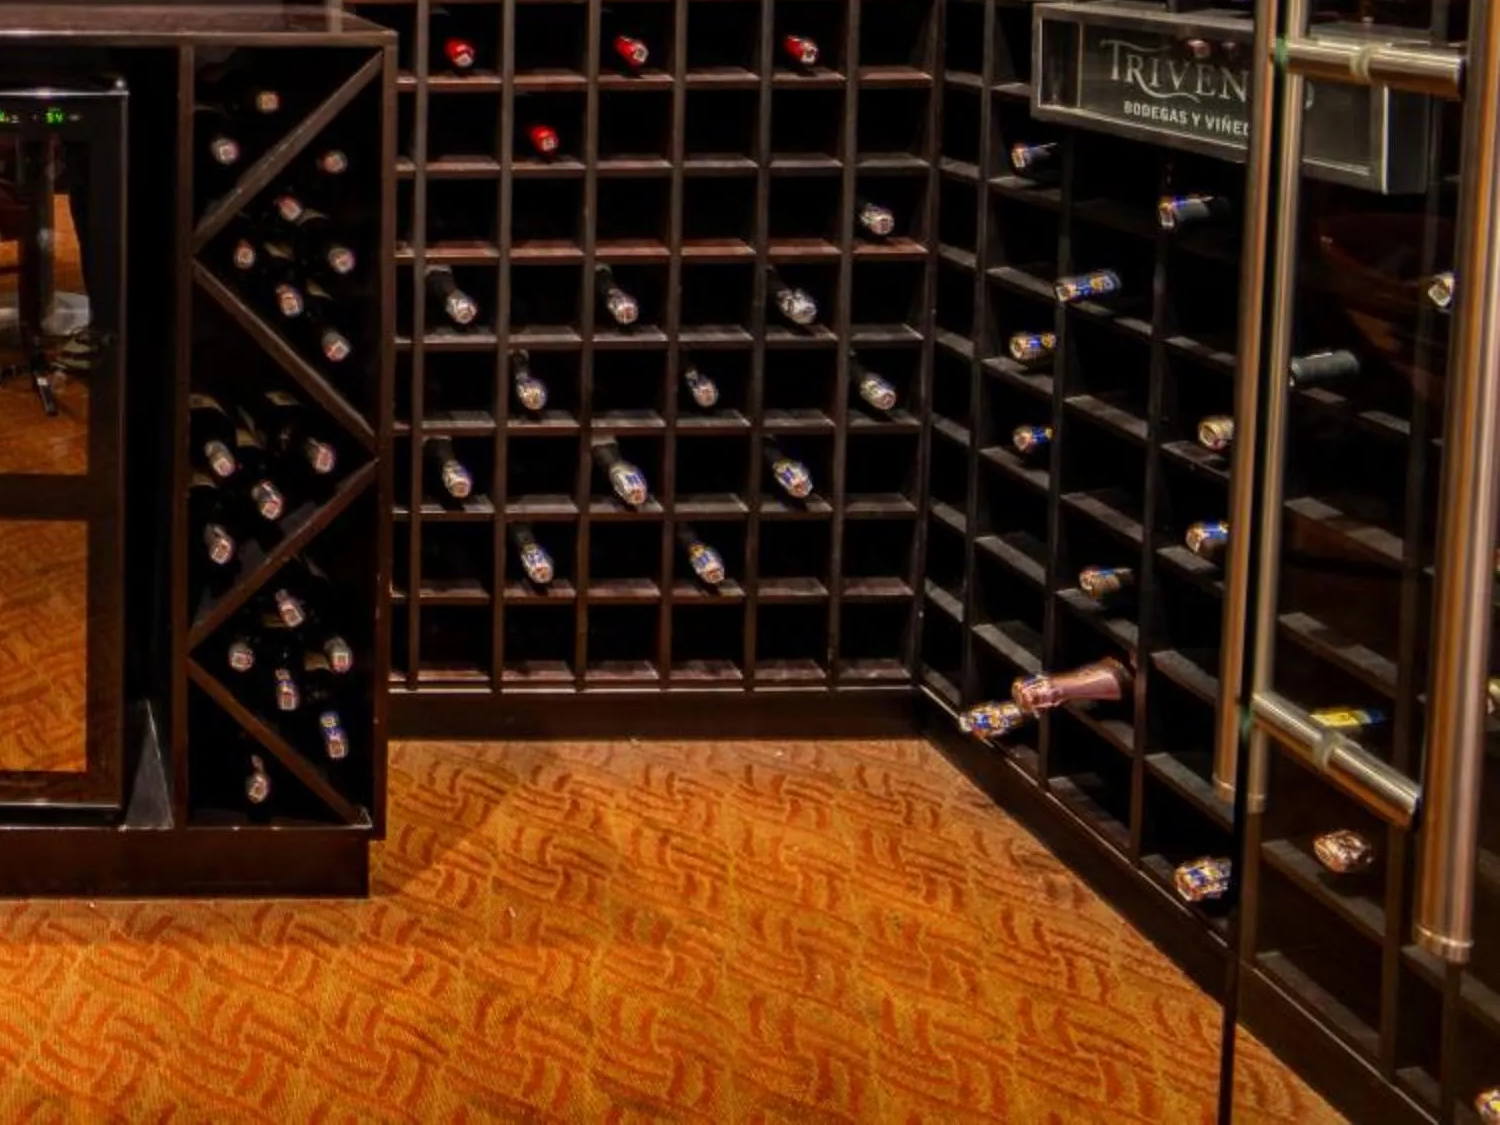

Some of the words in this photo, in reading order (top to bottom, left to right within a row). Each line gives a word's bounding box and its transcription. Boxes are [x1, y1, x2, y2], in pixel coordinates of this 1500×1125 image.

[1100, 39, 1314, 110] TRIVEN
[1123, 100, 1188, 124] BODEGAS
[1191, 111, 1201, 127] Y
[1204, 113, 1249, 137] VIÑE
